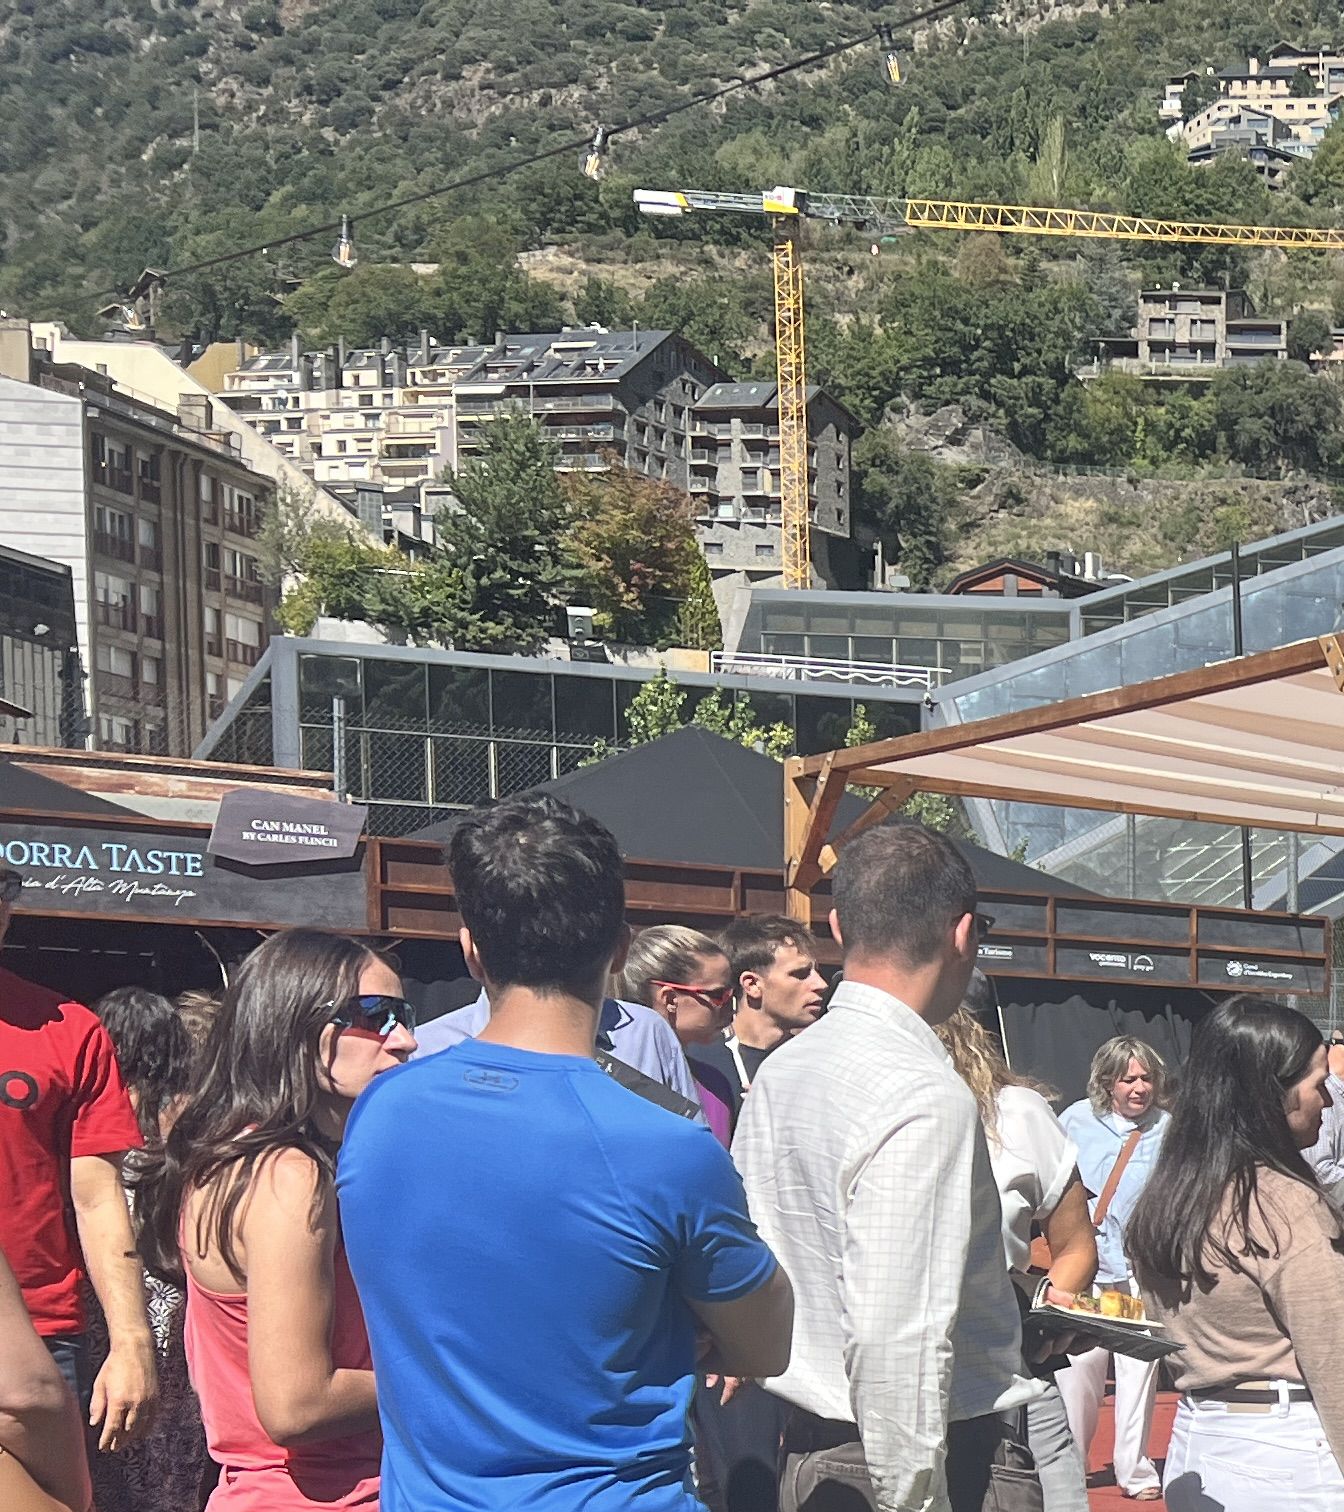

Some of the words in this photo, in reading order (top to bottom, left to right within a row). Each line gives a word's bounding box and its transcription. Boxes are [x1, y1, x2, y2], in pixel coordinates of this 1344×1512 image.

[251, 819, 281, 832] CAN
[281, 822, 329, 836] MANEL
[242, 831, 257, 841] BY
[257, 832, 298, 844] CARLES
[0, 840, 99, 870] ORRA
[101, 843, 204, 877] TASTE
